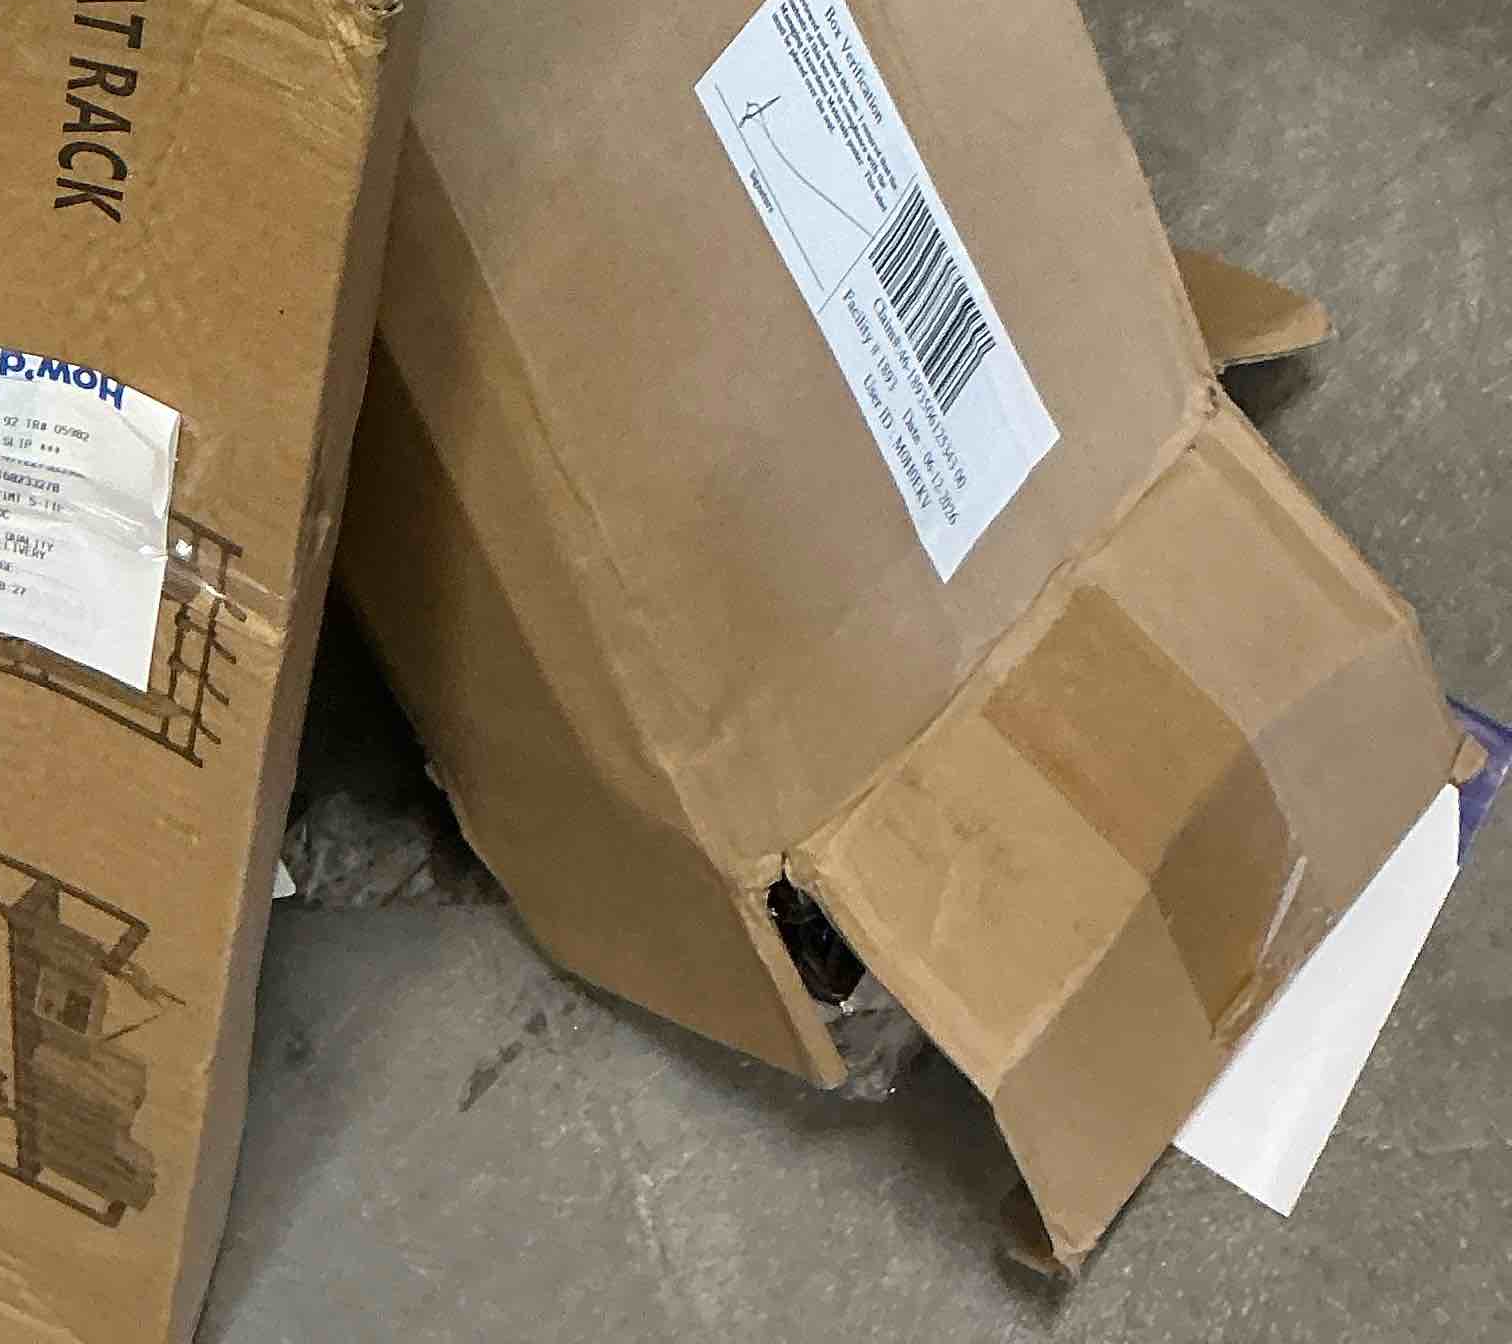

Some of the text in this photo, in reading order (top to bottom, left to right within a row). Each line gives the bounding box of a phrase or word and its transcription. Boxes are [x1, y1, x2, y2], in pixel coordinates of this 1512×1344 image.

[823, 3, 888, 125] Box Verification
[53, 55, 138, 225] RACK
[839, 285, 877, 350] Facility
[859, 370, 886, 413] User
[1, 434, 34, 450] SLIP
